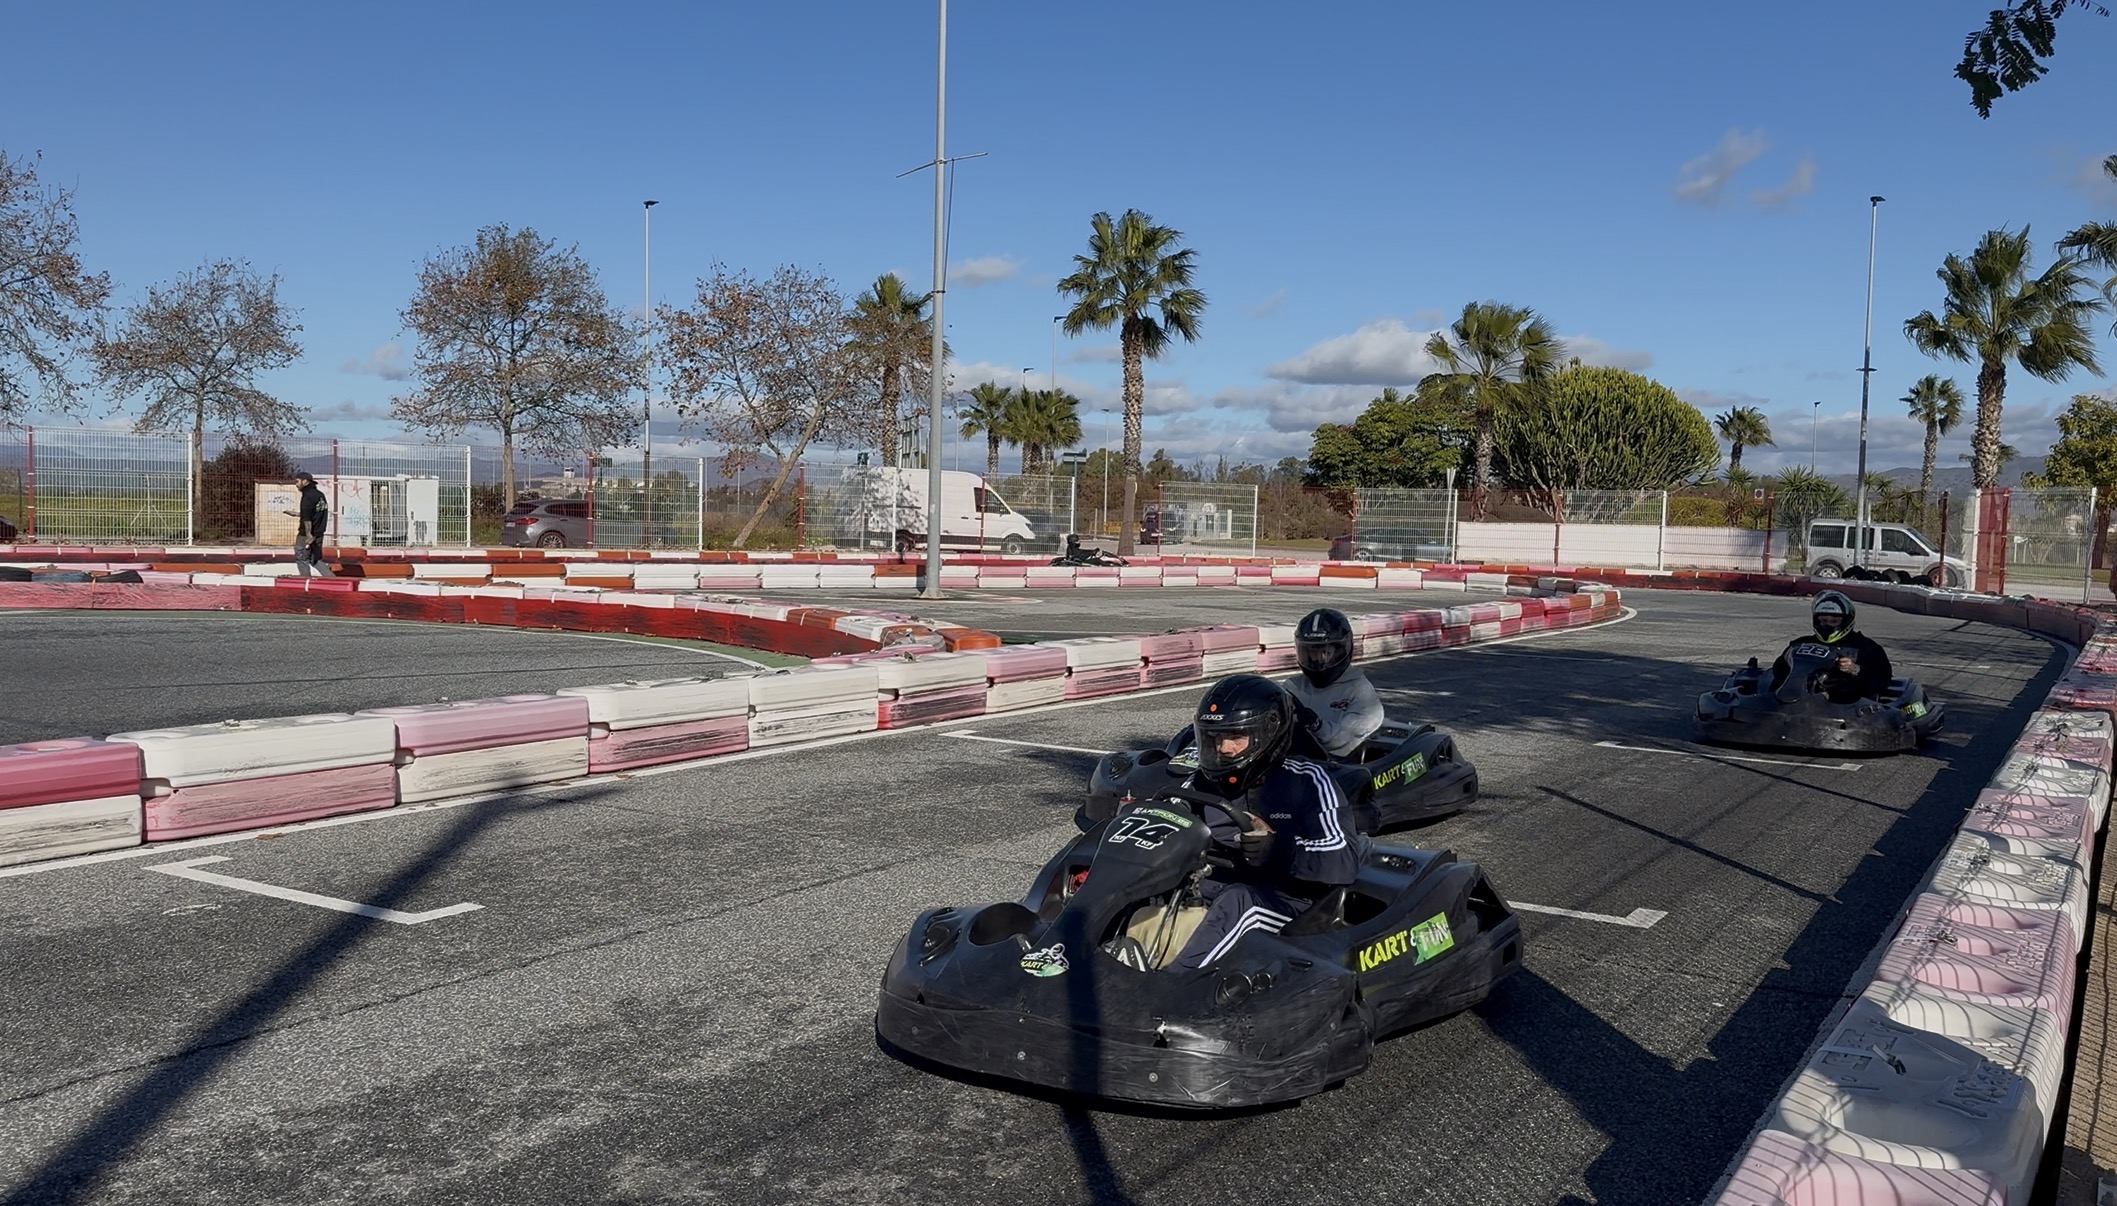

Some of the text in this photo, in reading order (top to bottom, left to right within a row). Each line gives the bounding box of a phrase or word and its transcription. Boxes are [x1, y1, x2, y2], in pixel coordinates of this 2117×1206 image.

[1373, 764, 1400, 790] KART
[1108, 816, 1179, 850] 14
[1359, 930, 1407, 972] KART
